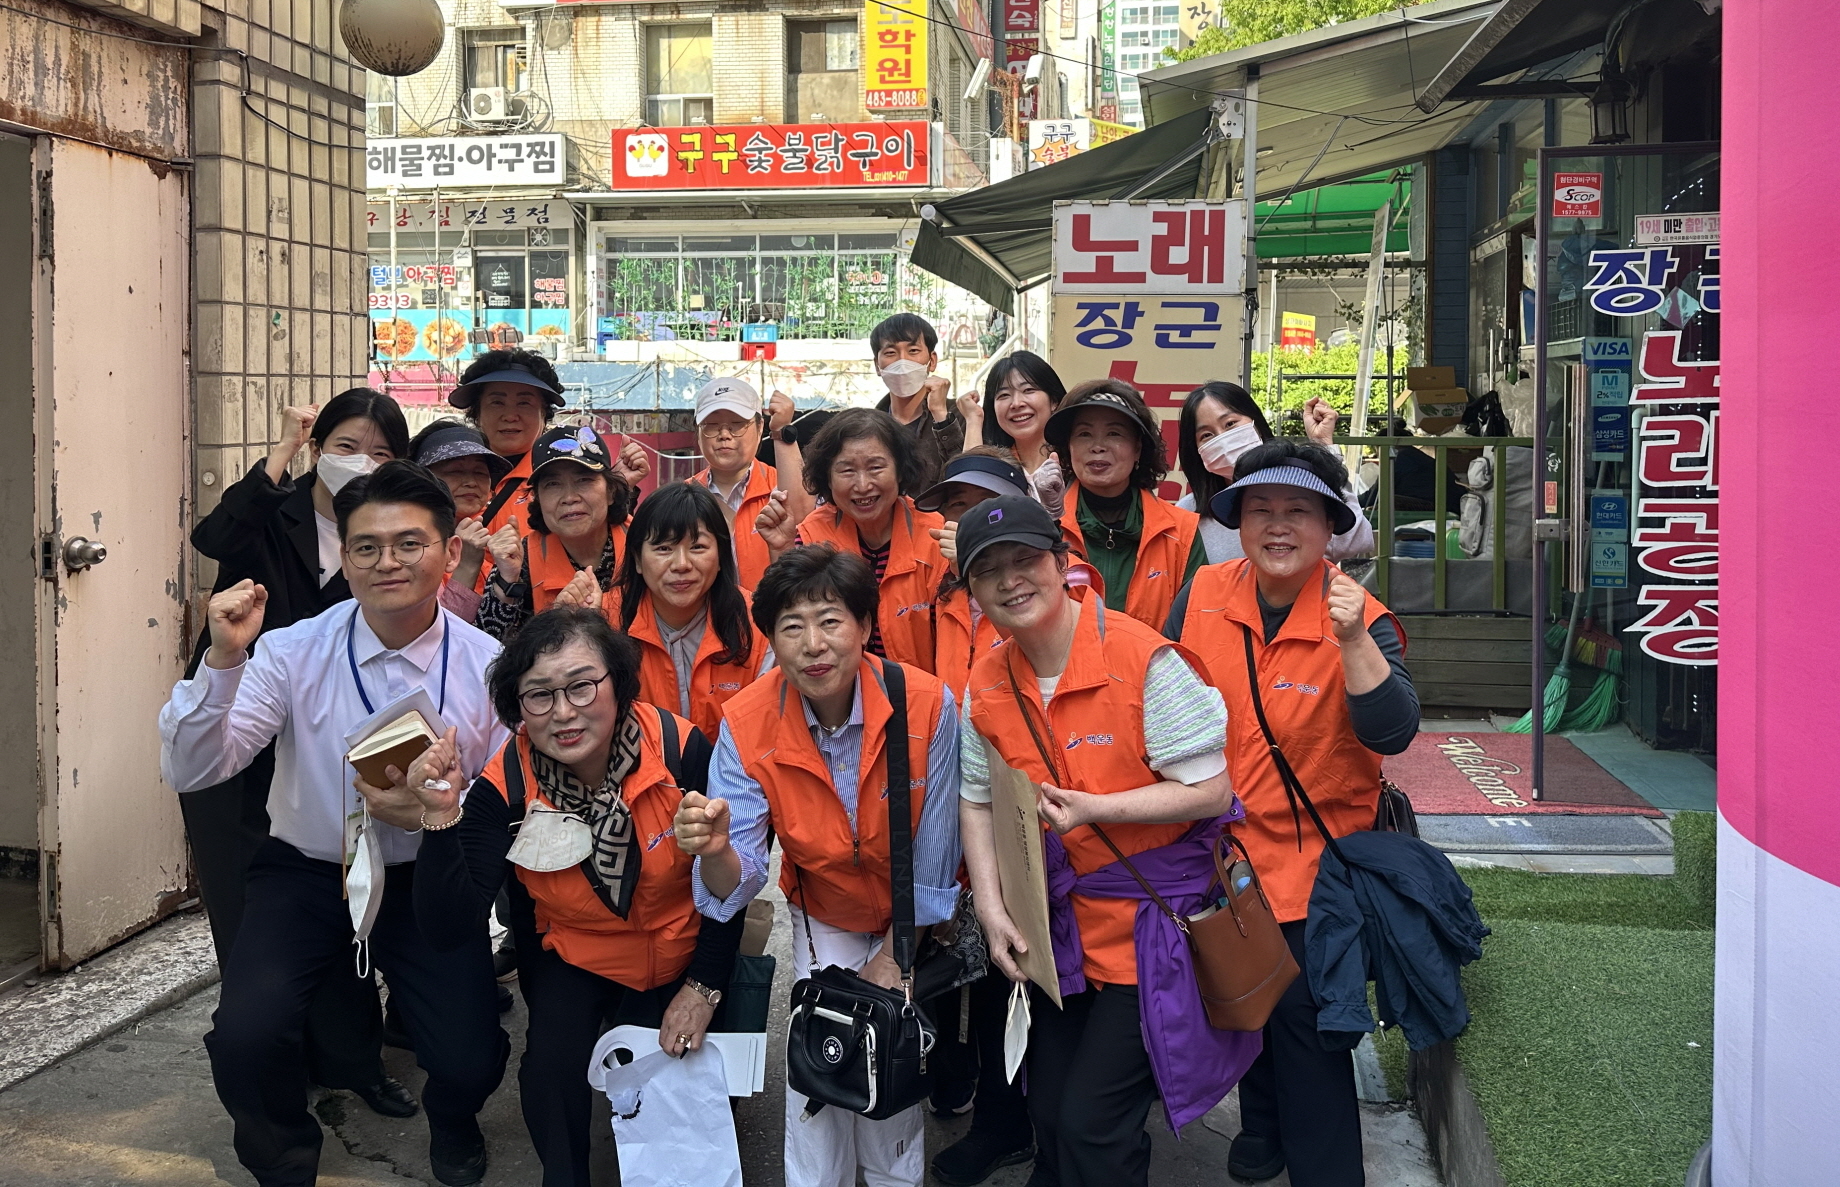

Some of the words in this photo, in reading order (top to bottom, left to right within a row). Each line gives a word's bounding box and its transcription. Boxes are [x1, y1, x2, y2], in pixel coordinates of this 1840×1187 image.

[1008, 0, 1033, 28] 숙
[866, 90, 918, 107] 483-8088
[1043, 124, 1075, 142] 구구
[367, 140, 556, 178] 해물찜·아구찜
[677, 132, 740, 175] 구구
[742, 129, 915, 174] 숯불닭구이
[1560, 176, 1597, 184] 첨단경비구역
[1564, 188, 1595, 202] SCOP
[1639, 219, 1661, 234] 19세
[1663, 218, 1683, 234] 미만
[1685, 216, 1720, 233] 출입·고
[1062, 208, 1226, 284] 노래
[405, 265, 457, 286] 아구찜
[1074, 301, 1223, 350] 장군
[1589, 342, 1630, 356] VISA
[1602, 375, 1619, 386] M
[1595, 429, 1625, 439] 삼성카드
[1086, 733, 1114, 746] 백운동
[1435, 736, 1530, 808] Welcome
